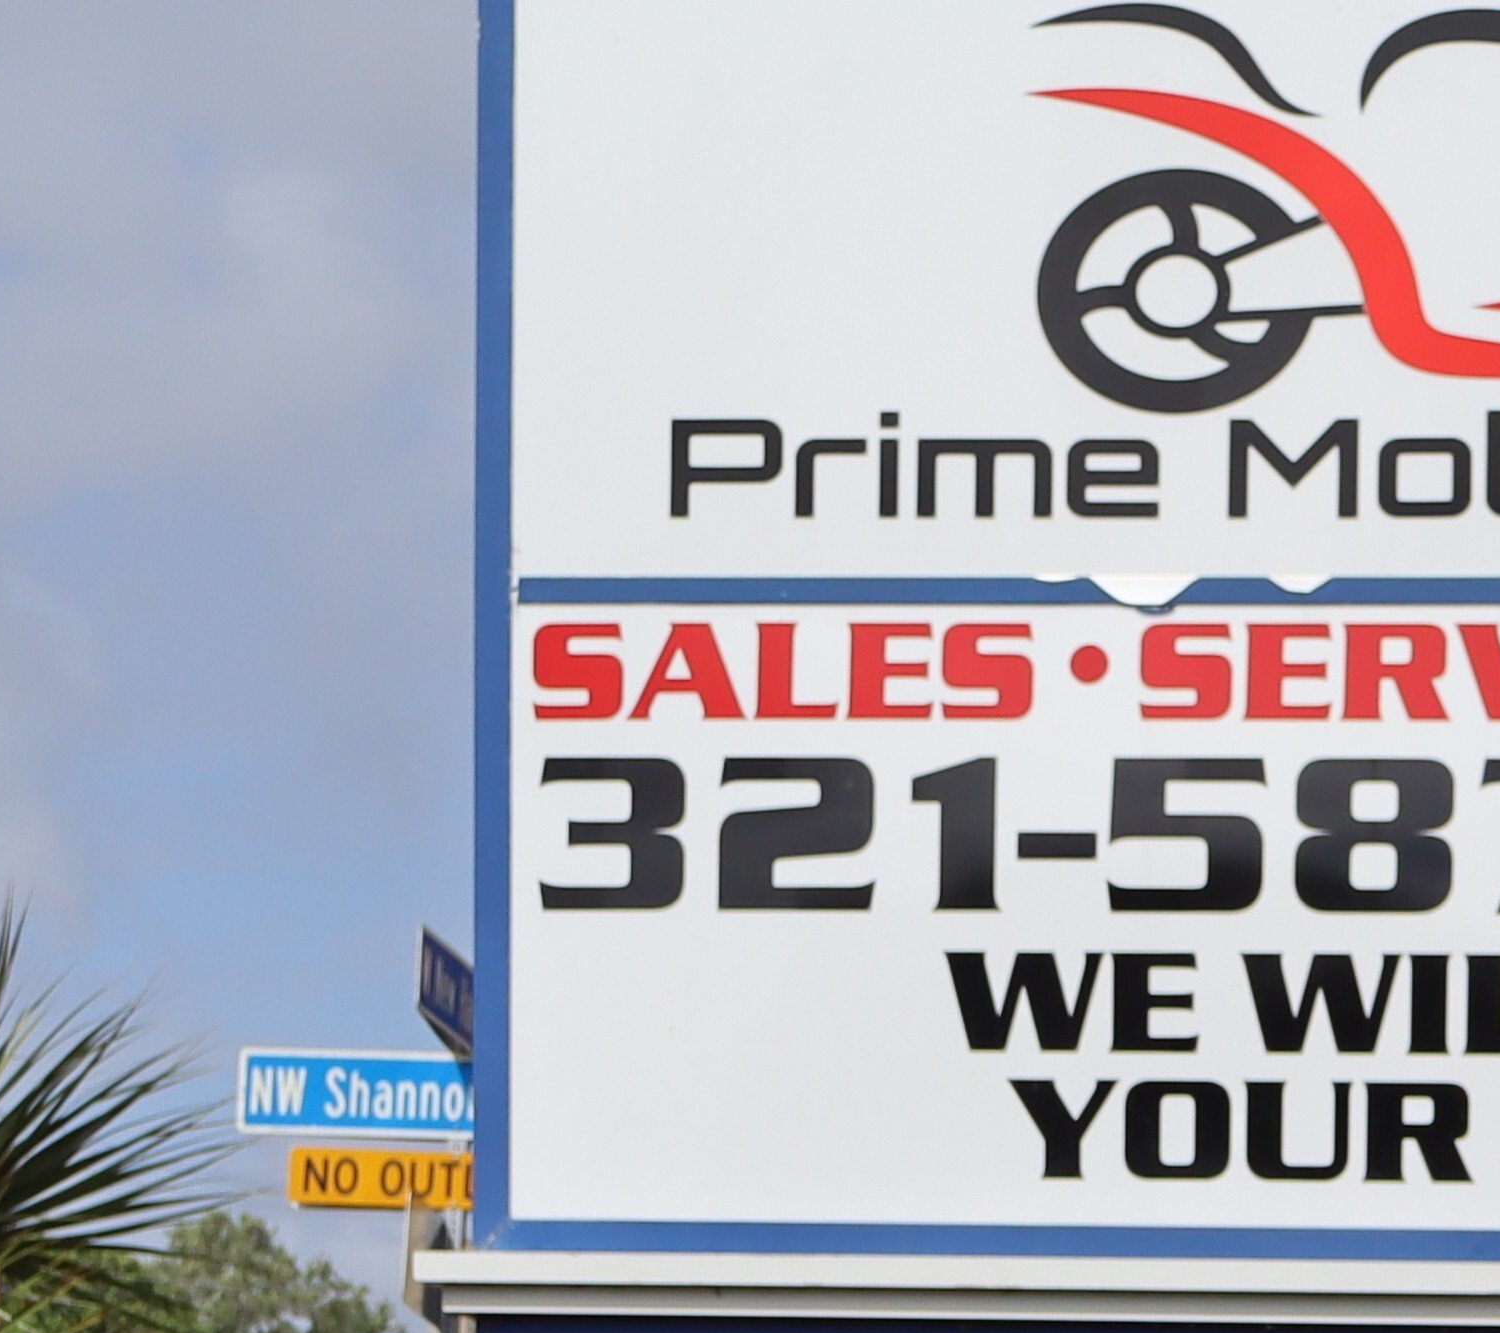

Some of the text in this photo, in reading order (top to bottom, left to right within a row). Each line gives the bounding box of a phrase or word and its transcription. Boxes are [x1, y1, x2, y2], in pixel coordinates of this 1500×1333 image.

[670, 410, 1161, 519] Prime
[534, 623, 1033, 720] SALES
[946, 953, 1198, 1053] WE
[250, 1066, 307, 1116] NW
[1010, 1080, 1471, 1182] YOUR
[303, 1158, 358, 1193] NO
